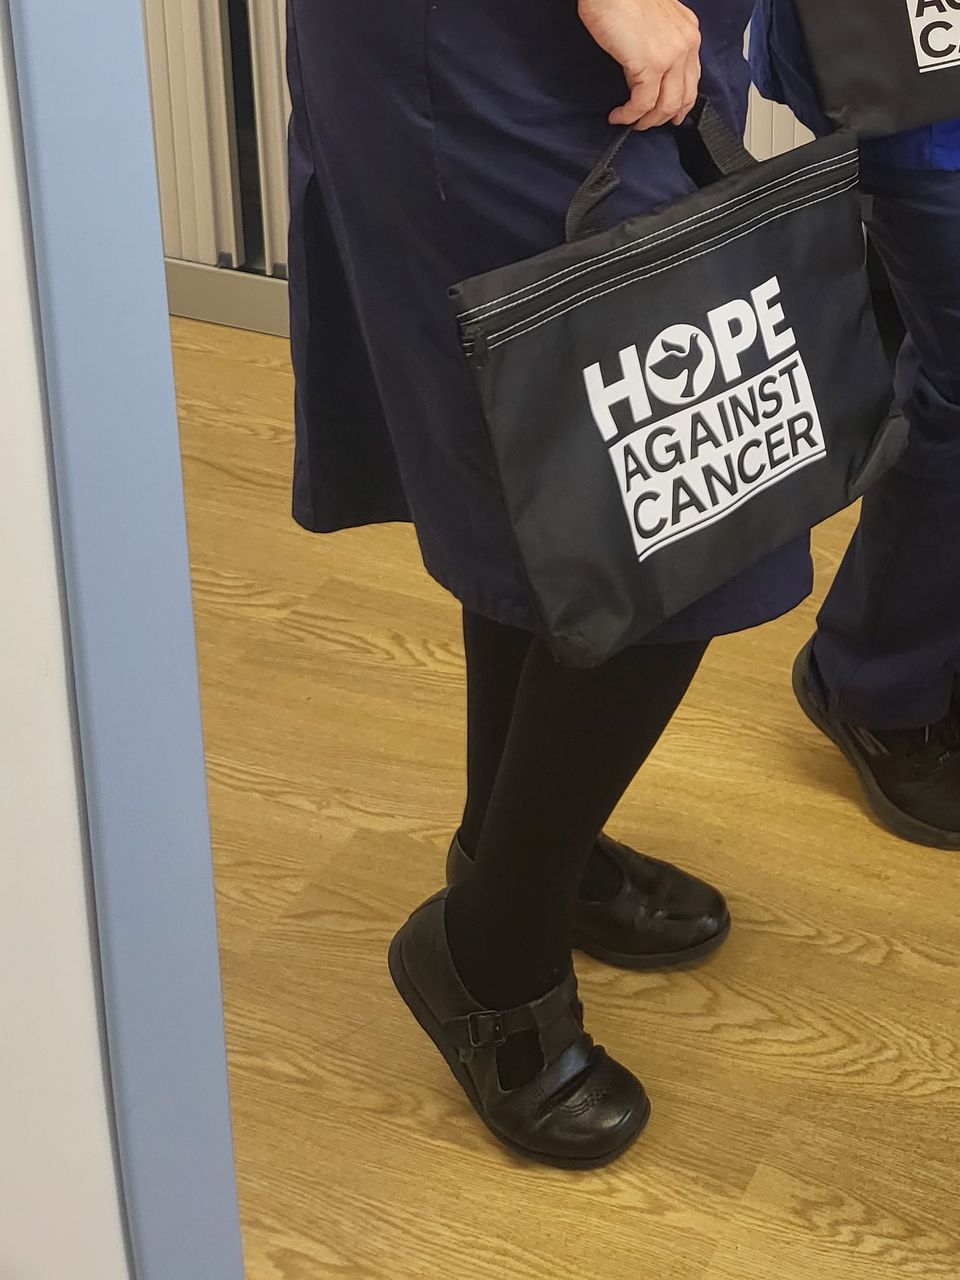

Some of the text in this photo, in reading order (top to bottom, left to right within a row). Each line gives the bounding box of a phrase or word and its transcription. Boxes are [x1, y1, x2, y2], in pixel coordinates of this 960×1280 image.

[583, 276, 797, 442] HOPE
[625, 359, 802, 493] AGAINST
[632, 410, 819, 540] CANCER
